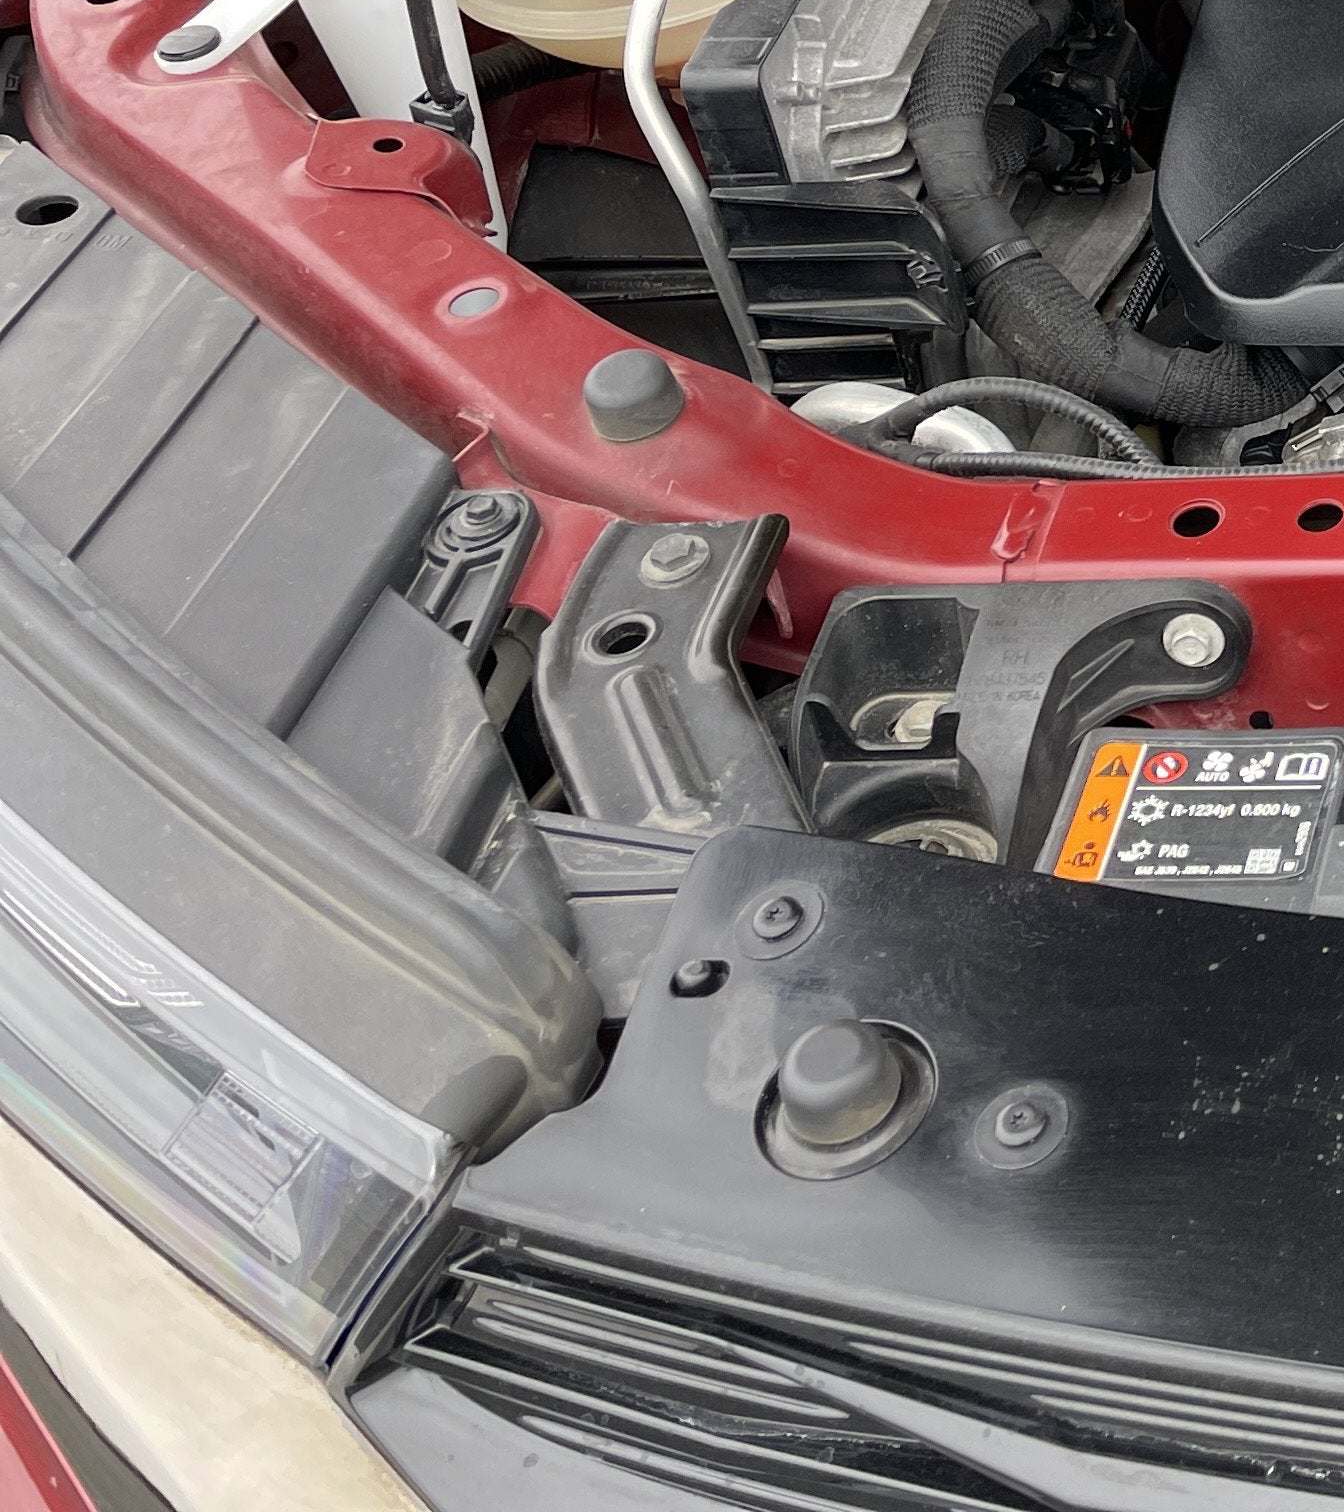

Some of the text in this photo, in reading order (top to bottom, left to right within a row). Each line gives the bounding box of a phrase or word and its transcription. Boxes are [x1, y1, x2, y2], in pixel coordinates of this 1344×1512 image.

[1194, 771, 1231, 782] AUTO
[1170, 803, 1237, 819] R-1234yf
[1281, 802, 1301, 818] kg
[1158, 844, 1190, 858] PAG
